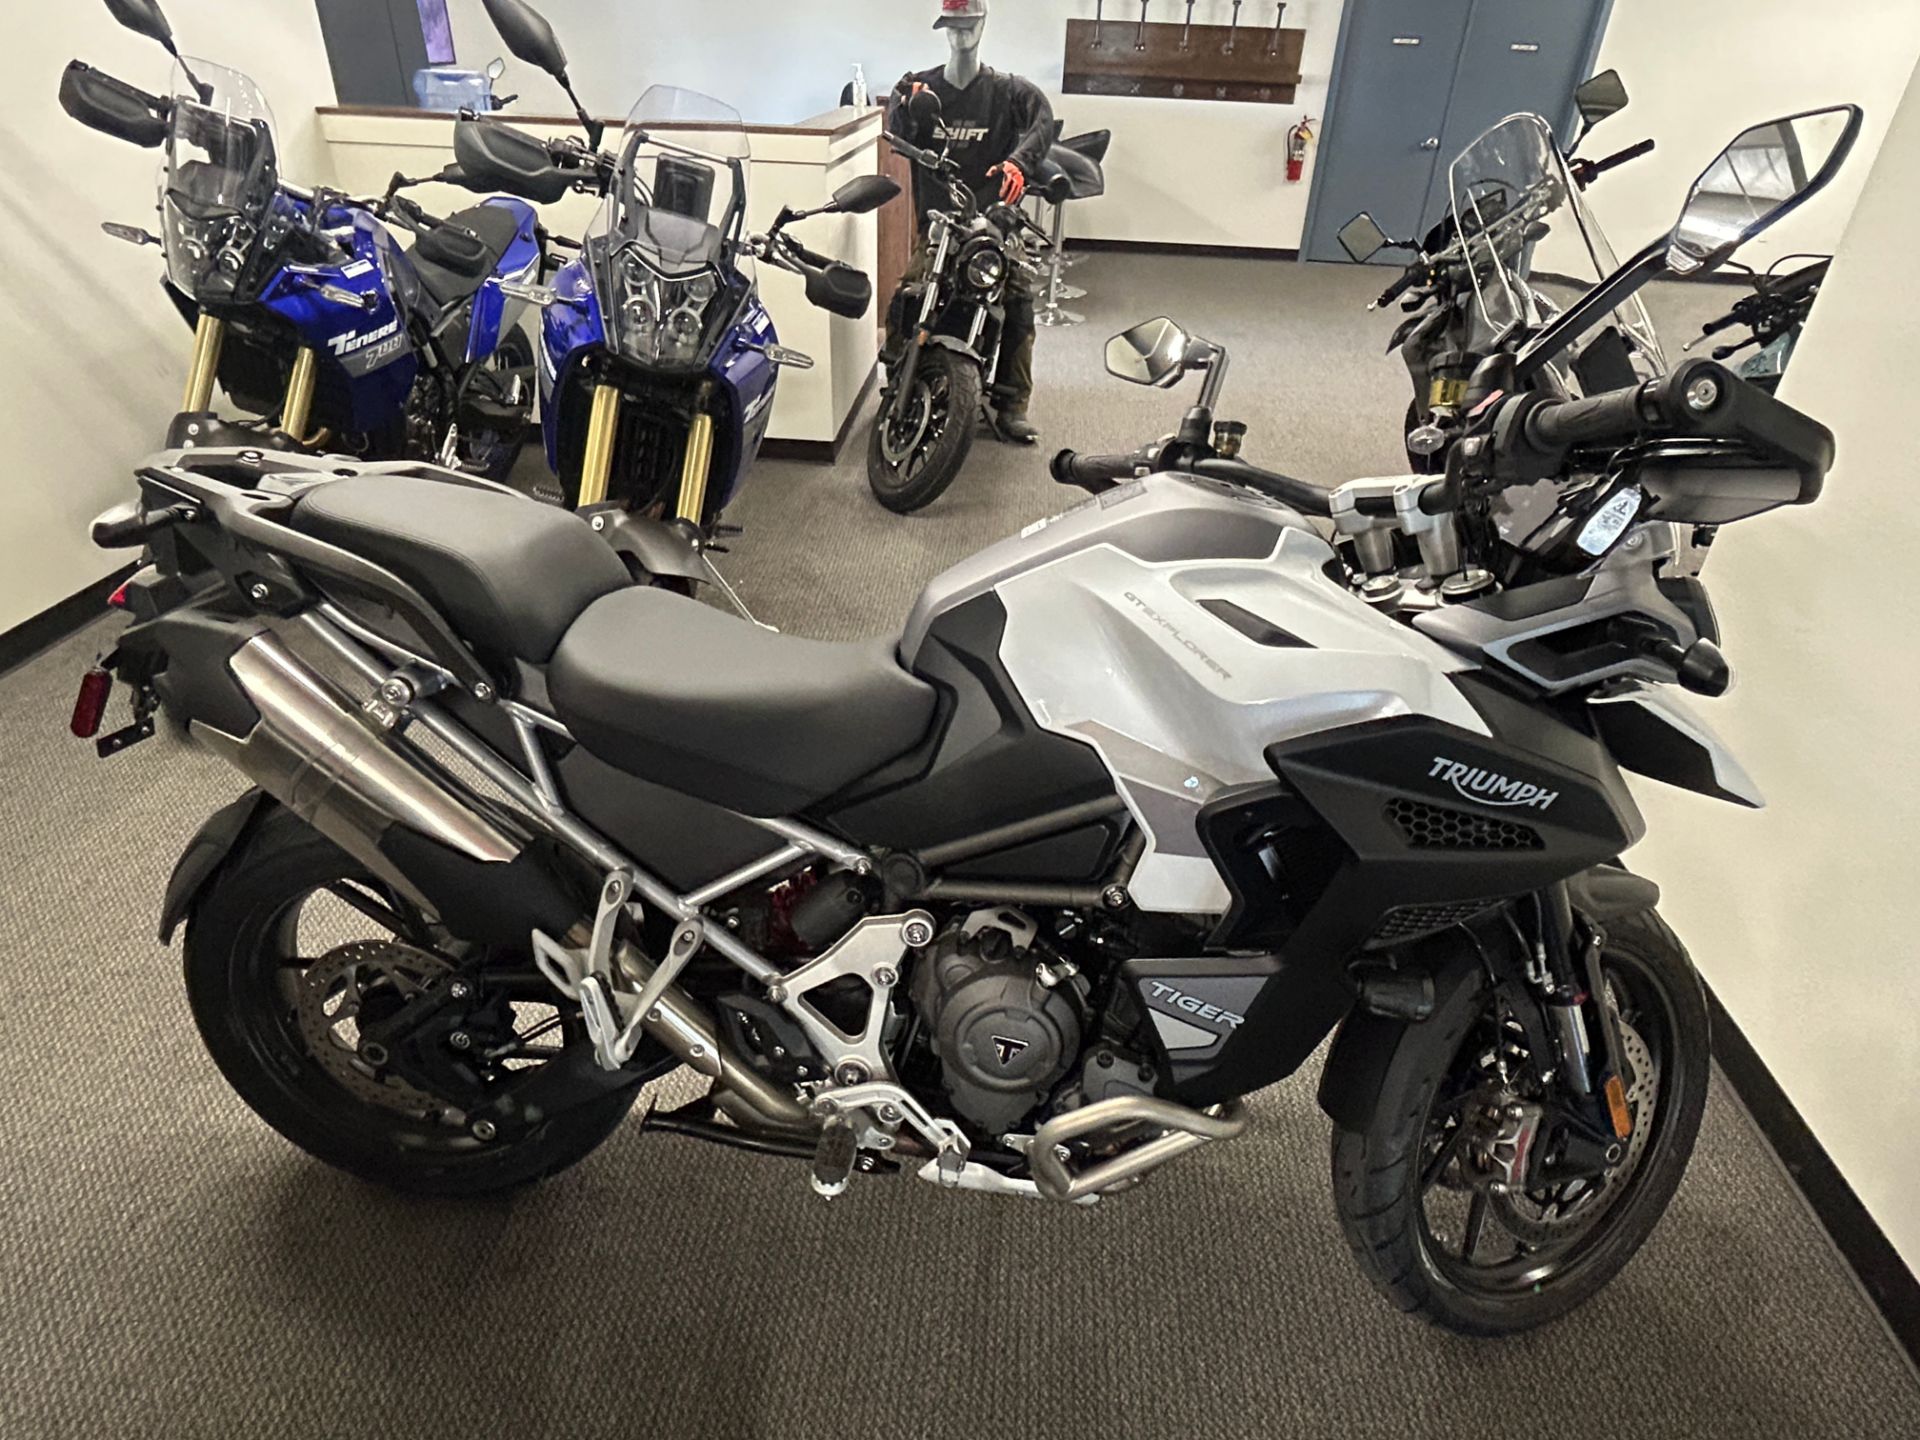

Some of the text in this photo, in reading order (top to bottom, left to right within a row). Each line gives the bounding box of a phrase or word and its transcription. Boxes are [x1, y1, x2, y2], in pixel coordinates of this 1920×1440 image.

[932, 126, 989, 141] SHIFT
[1428, 756, 1559, 810] TRIUMPH
[1151, 981, 1245, 1029] TIGER
